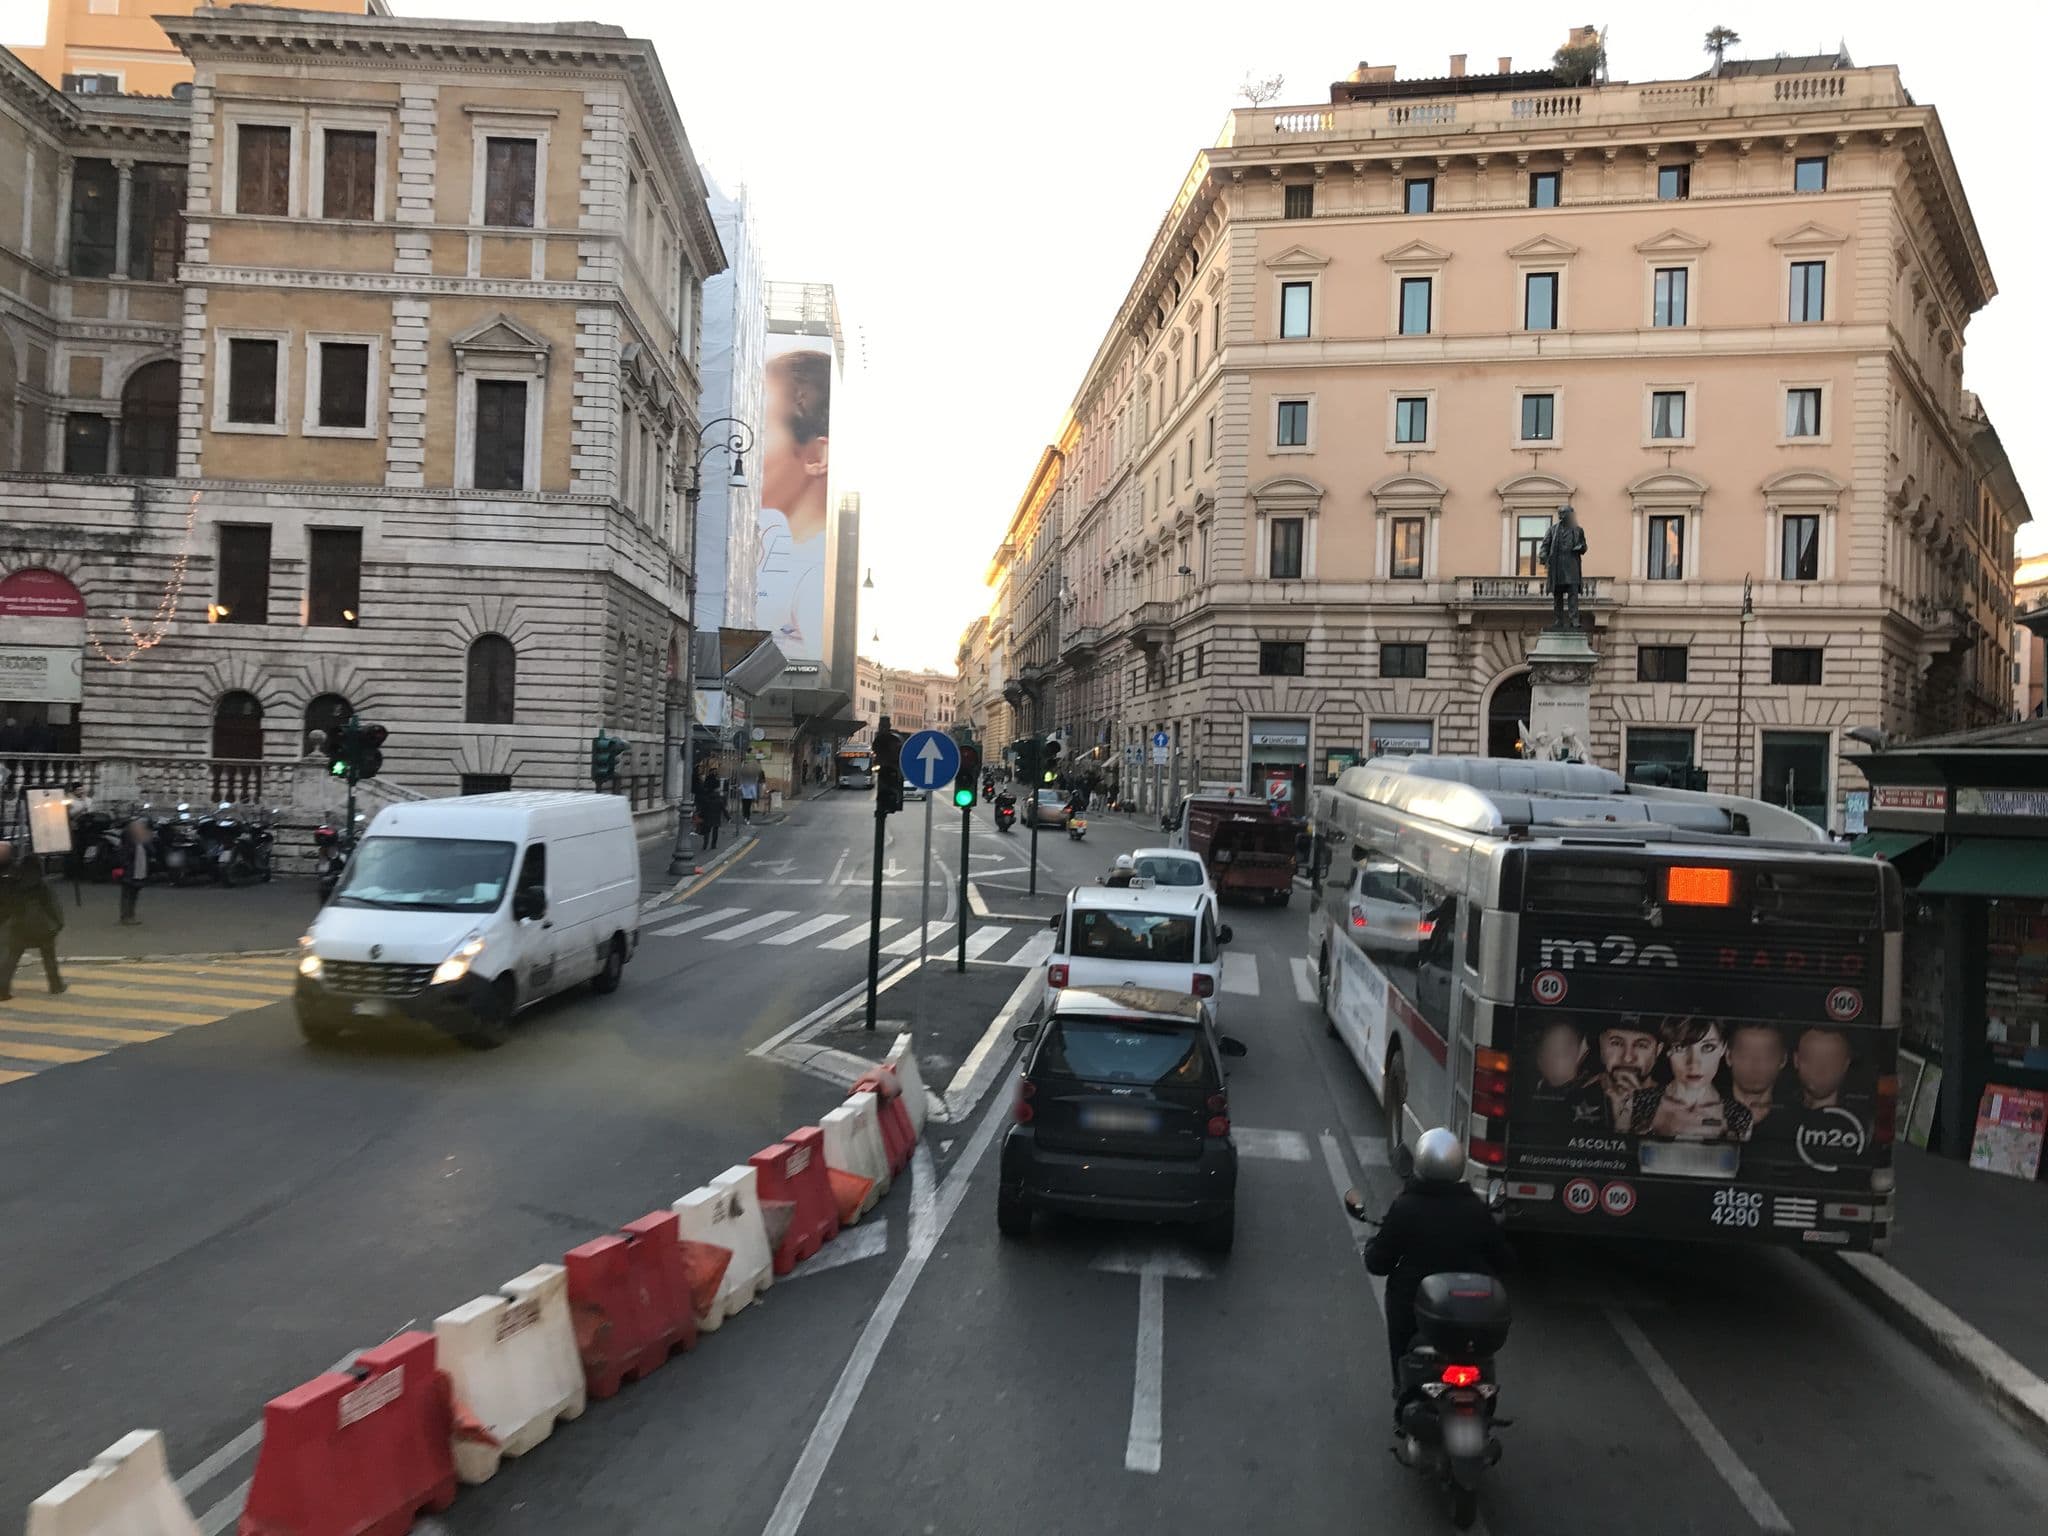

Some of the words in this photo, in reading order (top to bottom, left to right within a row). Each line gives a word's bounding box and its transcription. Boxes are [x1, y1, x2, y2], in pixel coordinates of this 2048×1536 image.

[1541, 979, 1559, 993] 80
[1833, 997, 1856, 1010] 100
[1567, 1138, 1627, 1151] ASCOLTA
[1805, 1129, 1858, 1147] m2o
[1572, 1187, 1590, 1203] 80
[1608, 1191, 1629, 1205] 100
[1713, 1187, 1763, 1207] atac
[1711, 1206, 1760, 1228] 4290
